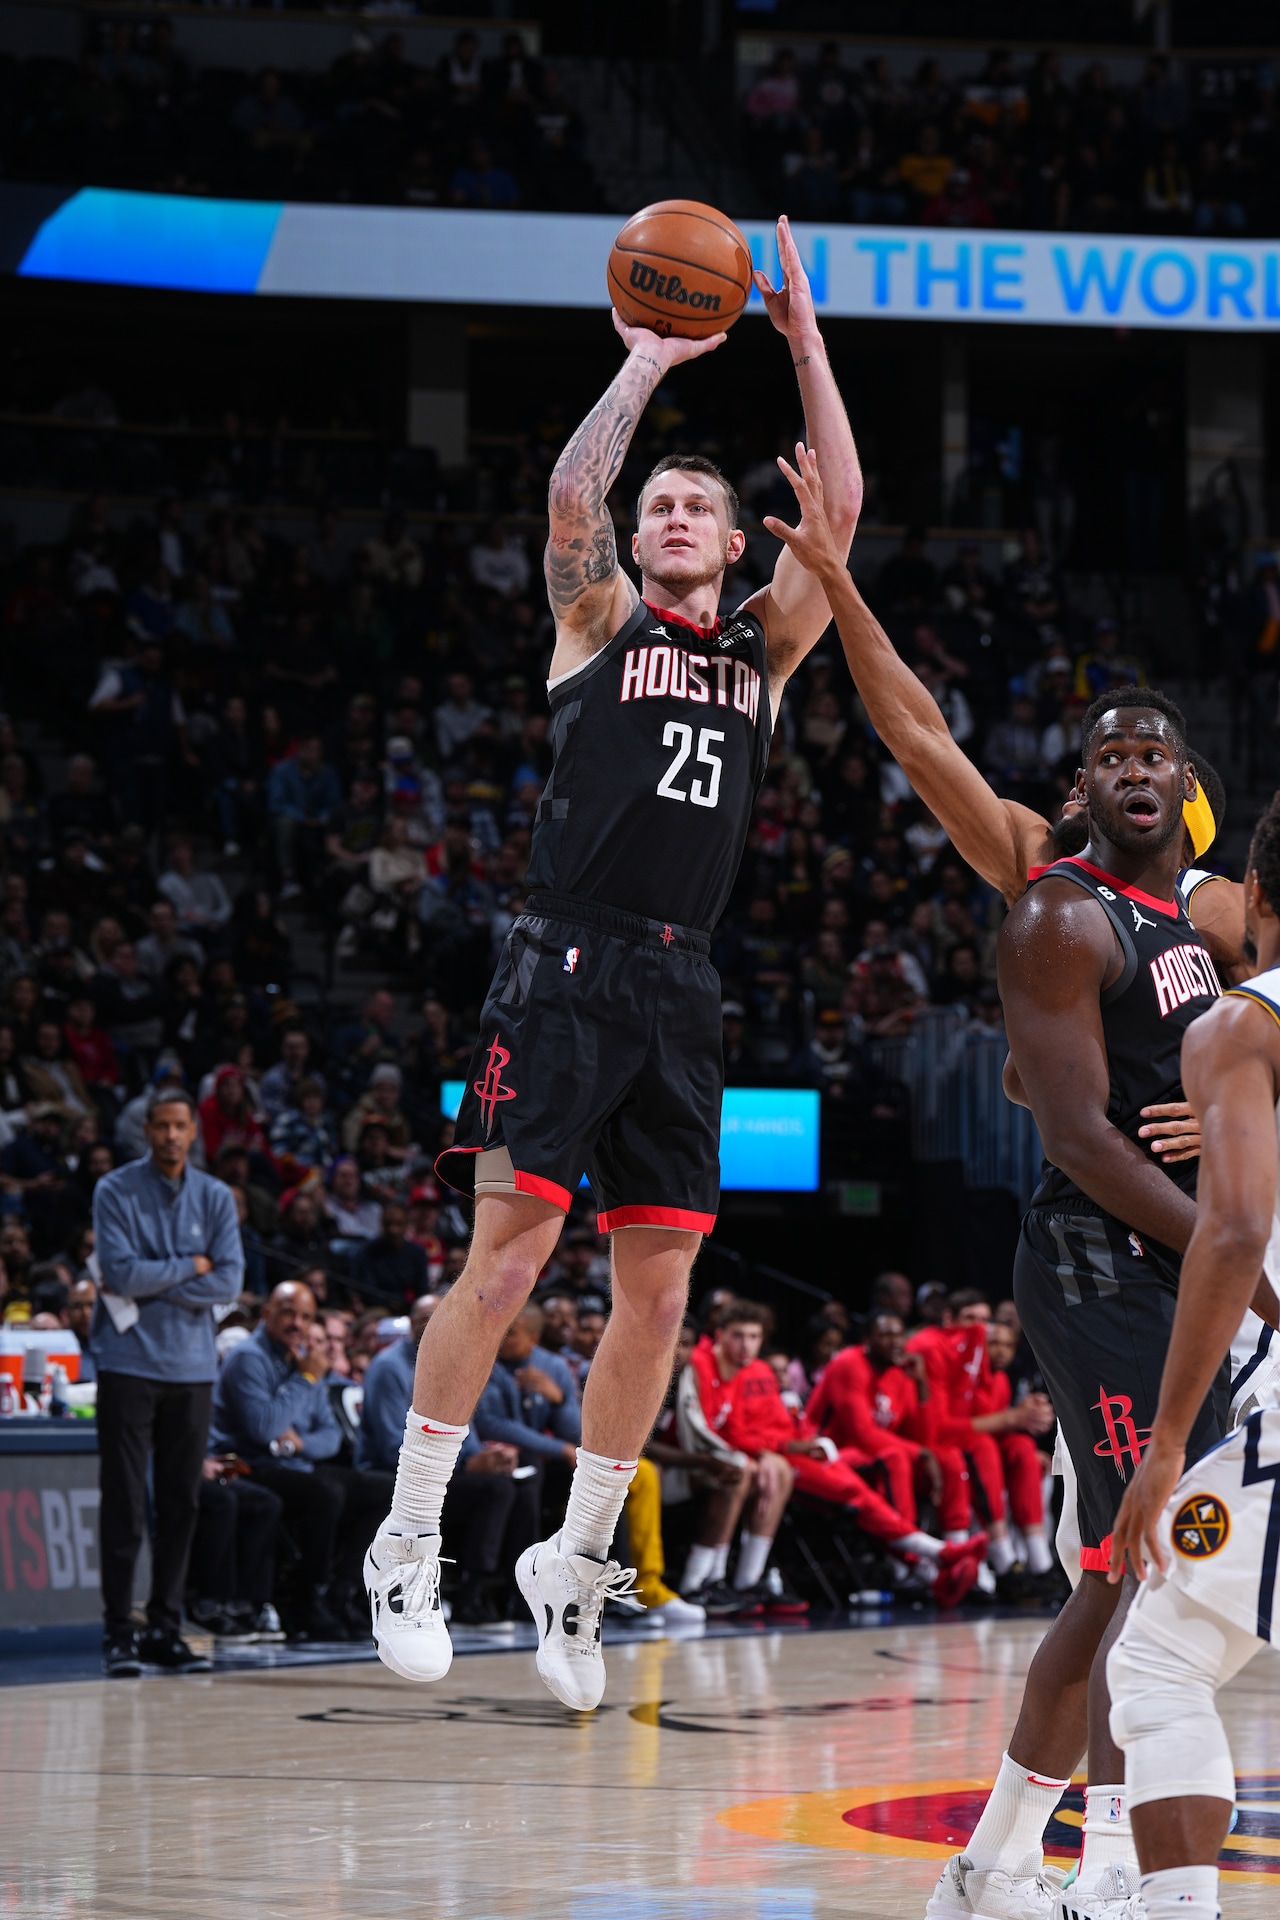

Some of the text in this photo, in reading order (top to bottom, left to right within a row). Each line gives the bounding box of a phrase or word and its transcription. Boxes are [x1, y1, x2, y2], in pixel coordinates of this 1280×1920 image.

[629, 259, 722, 312] Wilson
[856, 238, 1026, 312] THE
[1051, 244, 1280, 319] WORL
[619, 646, 761, 729] HOUSTON
[656, 720, 725, 808] 25
[1096, 885, 1117, 901] 6
